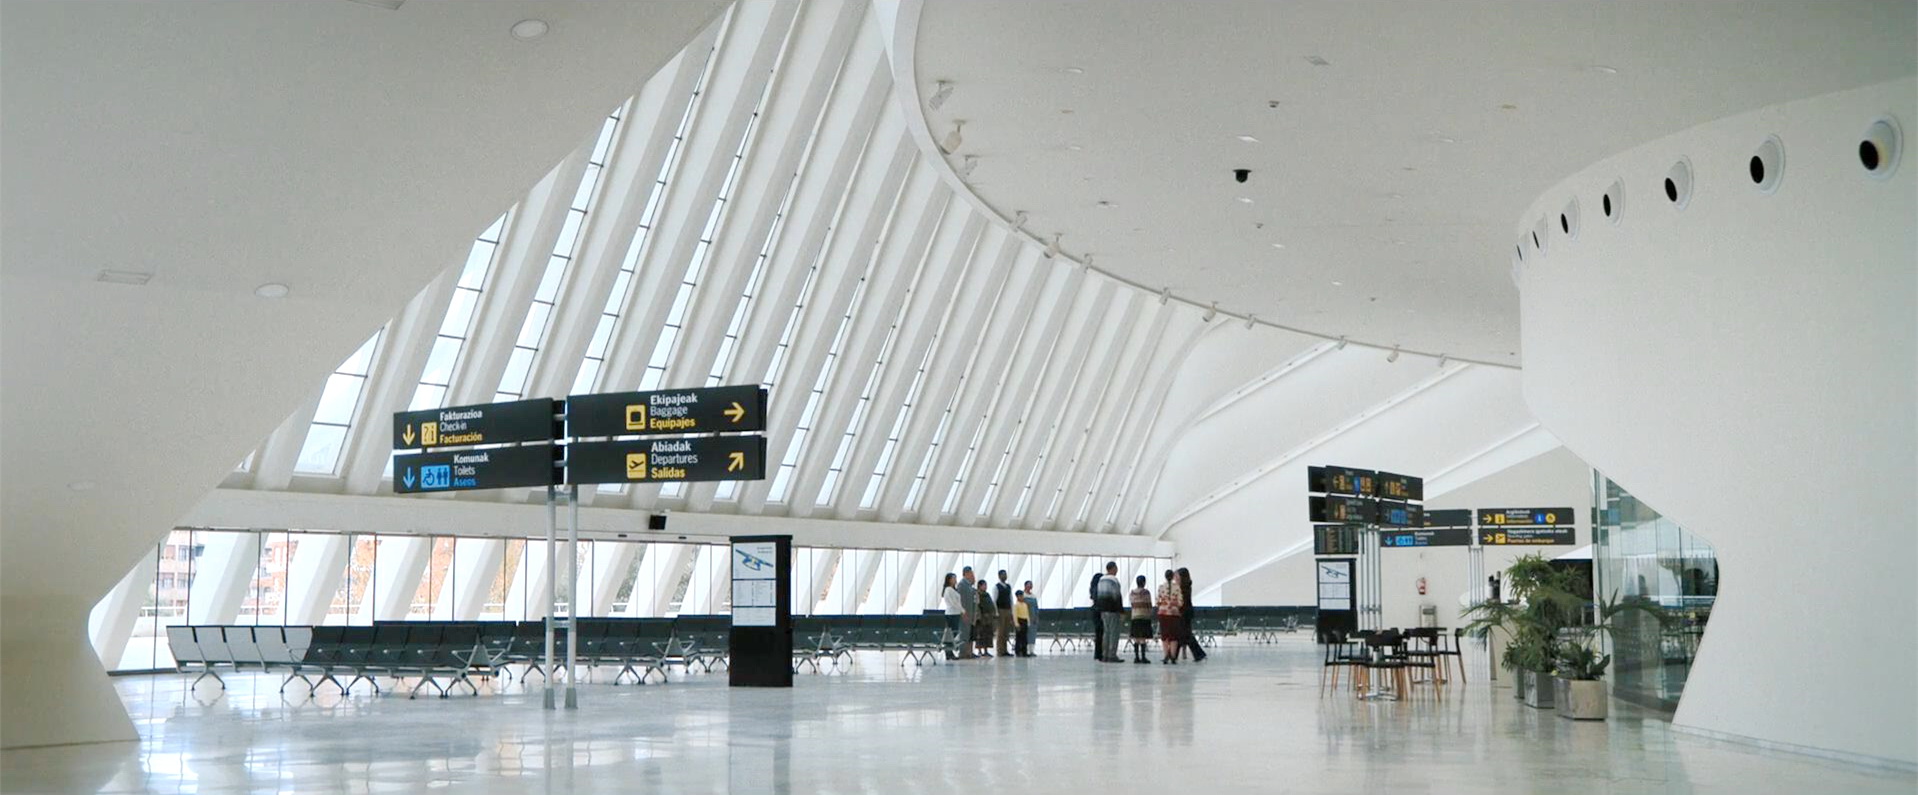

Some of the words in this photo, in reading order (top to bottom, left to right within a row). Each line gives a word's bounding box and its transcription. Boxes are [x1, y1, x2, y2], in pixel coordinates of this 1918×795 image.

[650, 393, 698, 407] Ekipajeak
[440, 409, 483, 421] Fakturazioa
[650, 405, 688, 417] Baggage
[650, 417, 696, 430] Equipajes
[440, 432, 483, 444] Facturación
[651, 441, 692, 452] Abiadak
[453, 453, 489, 463] Komunak
[651, 453, 699, 466] Departures
[453, 465, 476, 476] Toilets
[651, 467, 685, 479] Salidas
[453, 477, 476, 486] Aseos
